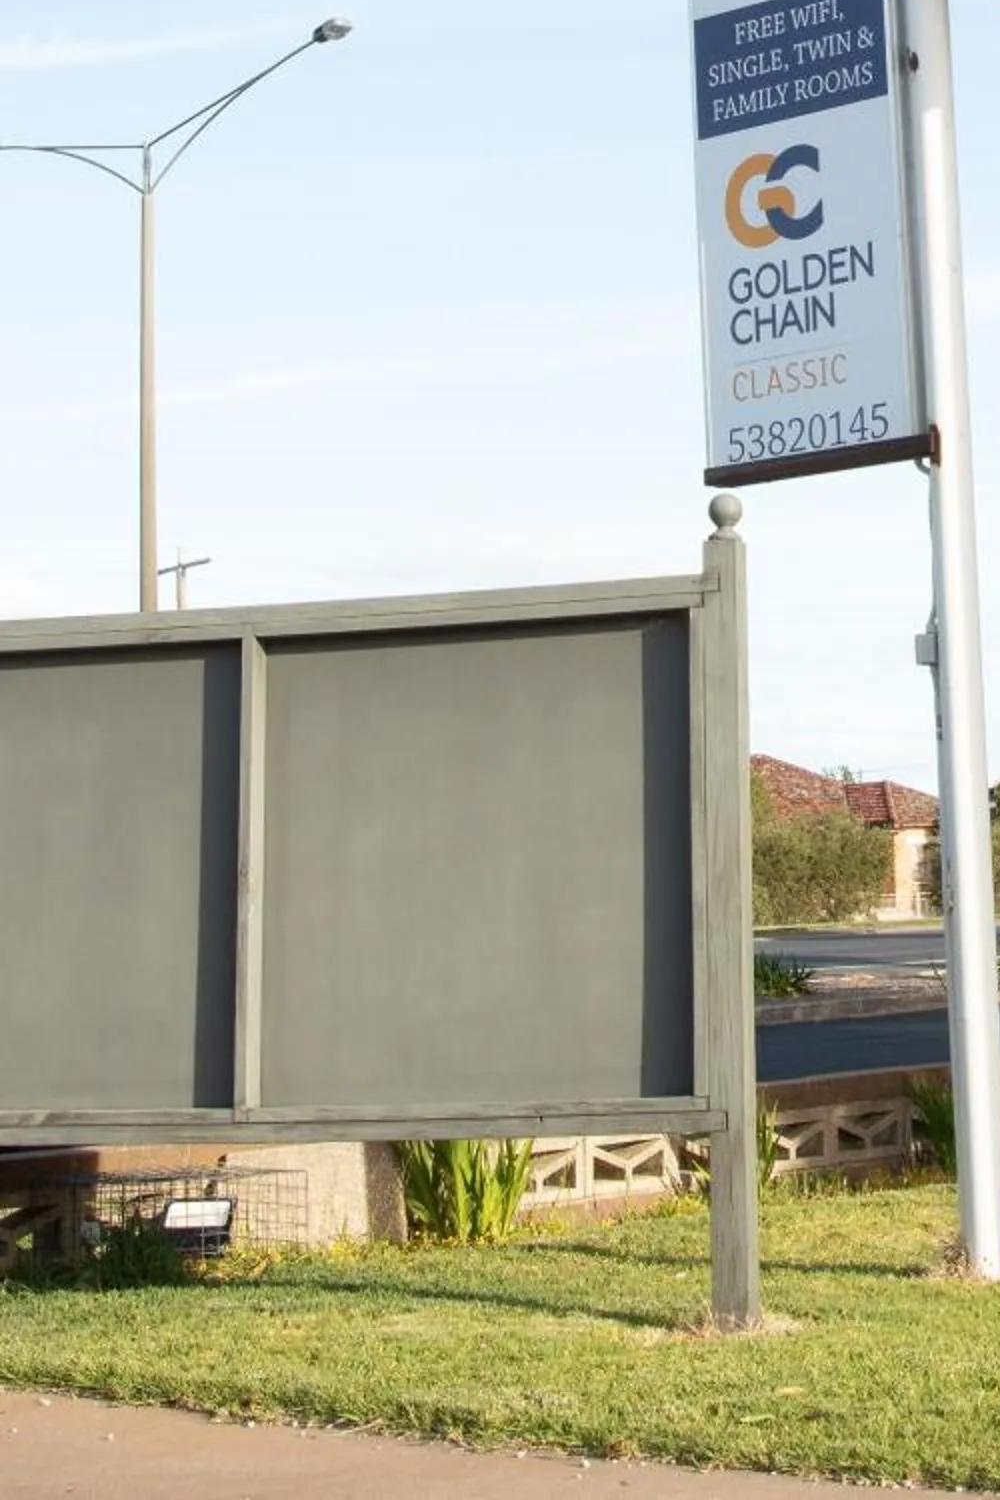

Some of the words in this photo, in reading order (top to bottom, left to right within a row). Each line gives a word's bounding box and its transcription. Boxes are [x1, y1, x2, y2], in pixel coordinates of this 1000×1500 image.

[708, 48, 790, 88] SINGLE,
[794, 31, 852, 66] TWIN
[857, 26, 875, 49] &
[734, 13, 785, 45] FREE
[713, 85, 789, 122] FAMILY
[795, 63, 874, 101] ROOMS
[728, 241, 875, 305] GOLDEN
[730, 292, 836, 345] CHAIN
[732, 354, 848, 402] CLASSIC
[728, 402, 890, 463] 53820145
